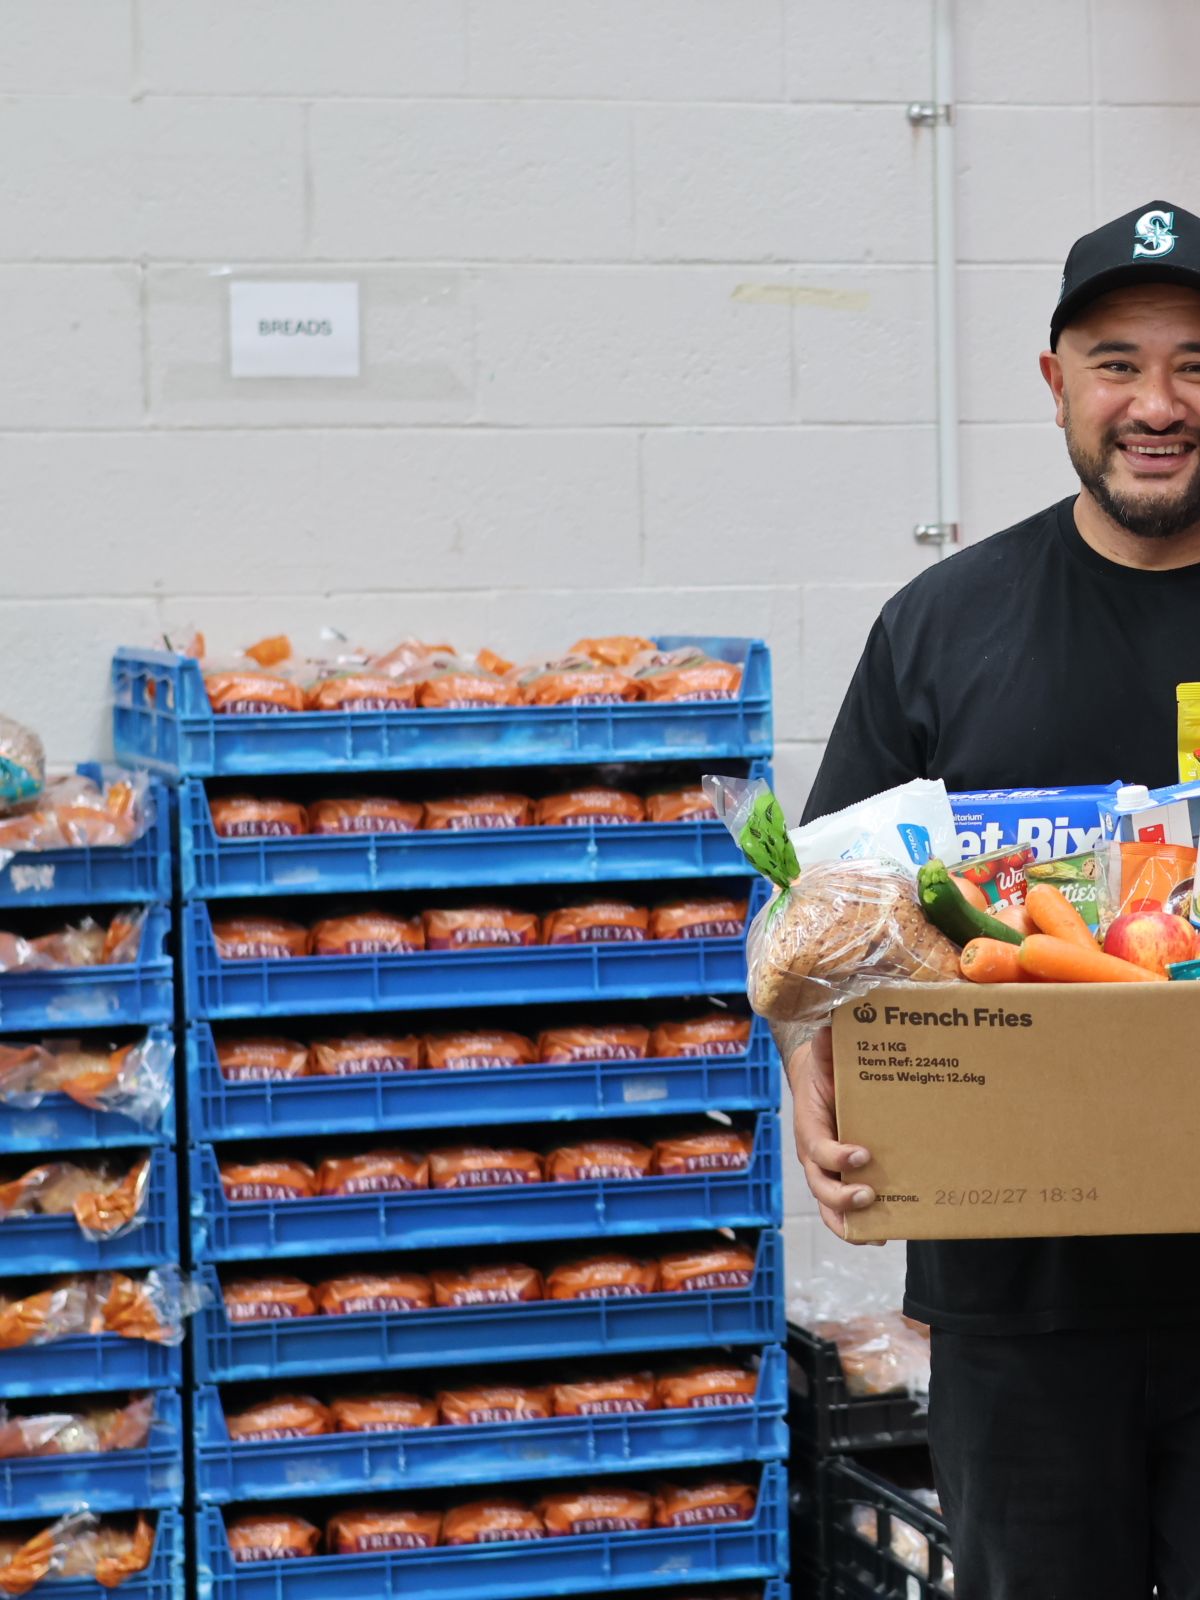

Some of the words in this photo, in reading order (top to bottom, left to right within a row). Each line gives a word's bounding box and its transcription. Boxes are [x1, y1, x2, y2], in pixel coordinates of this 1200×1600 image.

[1133, 211, 1175, 258] S
[258, 319, 333, 337] BREADS
[904, 828, 920, 860] value
[884, 1006, 969, 1026] French
[974, 1008, 1033, 1027] Fries
[857, 1041, 869, 1051] 12
[881, 1042, 886, 1052] 1
[888, 1042, 907, 1052] KG
[858, 1056, 886, 1067] Item
[888, 1056, 913, 1067] Ref:
[915, 1057, 959, 1068] 224410
[859, 1071, 895, 1082] Gross
[897, 1071, 944, 1084] Weight:
[946, 1073, 986, 1085] 12.6kg
[887, 1194, 919, 1202] BEFORE:
